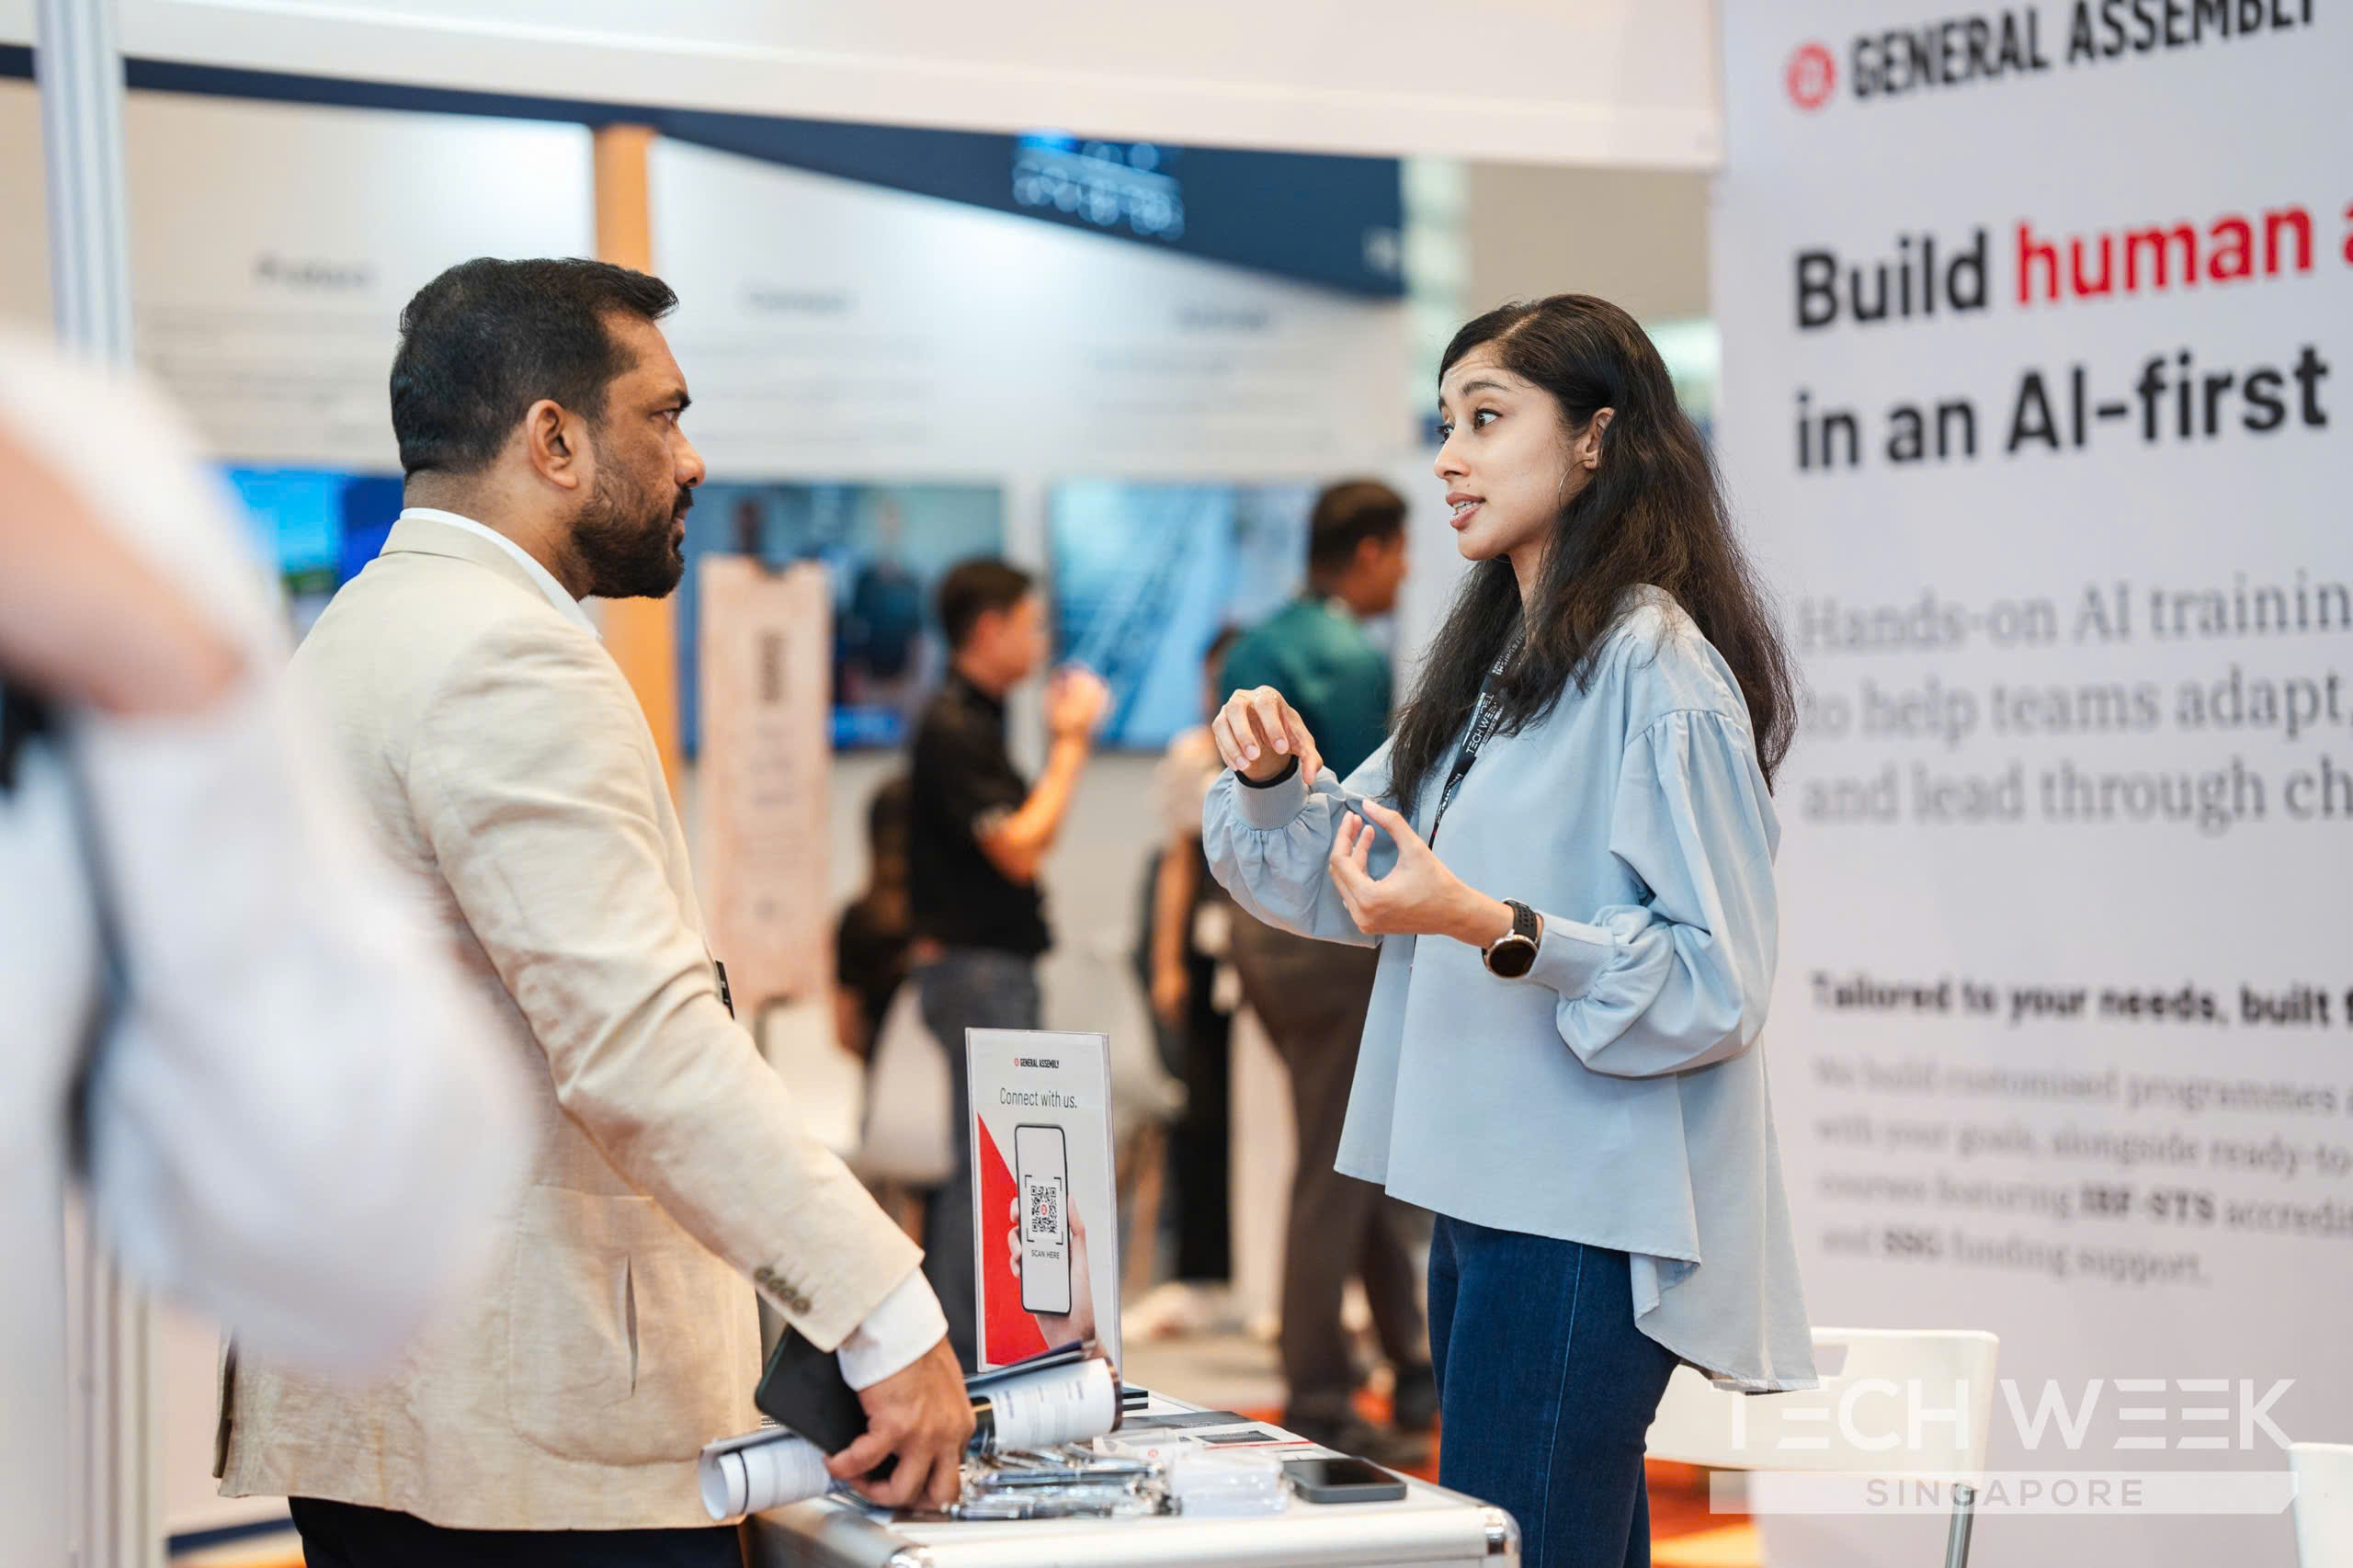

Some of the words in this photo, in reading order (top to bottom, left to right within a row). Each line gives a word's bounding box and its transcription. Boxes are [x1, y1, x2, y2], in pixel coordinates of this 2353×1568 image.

[1851, 8, 2050, 99] GENERAL
[1795, 229, 1988, 331] Build
[2017, 204, 2313, 305] human
[1797, 392, 1860, 472] in
[1886, 399, 1976, 464] an
[2006, 346, 2328, 455] AI-first
[1797, 588, 2058, 654] Hands-on
[2074, 581, 2132, 642] AI
[1465, 728, 1484, 754] TECH
[1860, 676, 1978, 750] help
[1991, 682, 2162, 733] teams
[1802, 762, 1899, 822] and
[1912, 760, 2026, 823] lead
[2040, 754, 2268, 835] through
[1812, 971, 1952, 1012] Tailored
[1961, 981, 1998, 1014] to
[2008, 985, 2086, 1025] your
[2240, 985, 2330, 1026] built
[1000, 1087, 1039, 1107] Connect
[1040, 1090, 1061, 1108] with
[1063, 1096, 1077, 1108] us.
[1019, 1058, 1039, 1067] GENERAL
[1039, 1059, 1059, 1069] ASSEMBLY
[1031, 1249, 1045, 1257] SCAN
[1046, 1250, 1060, 1259] HERE
